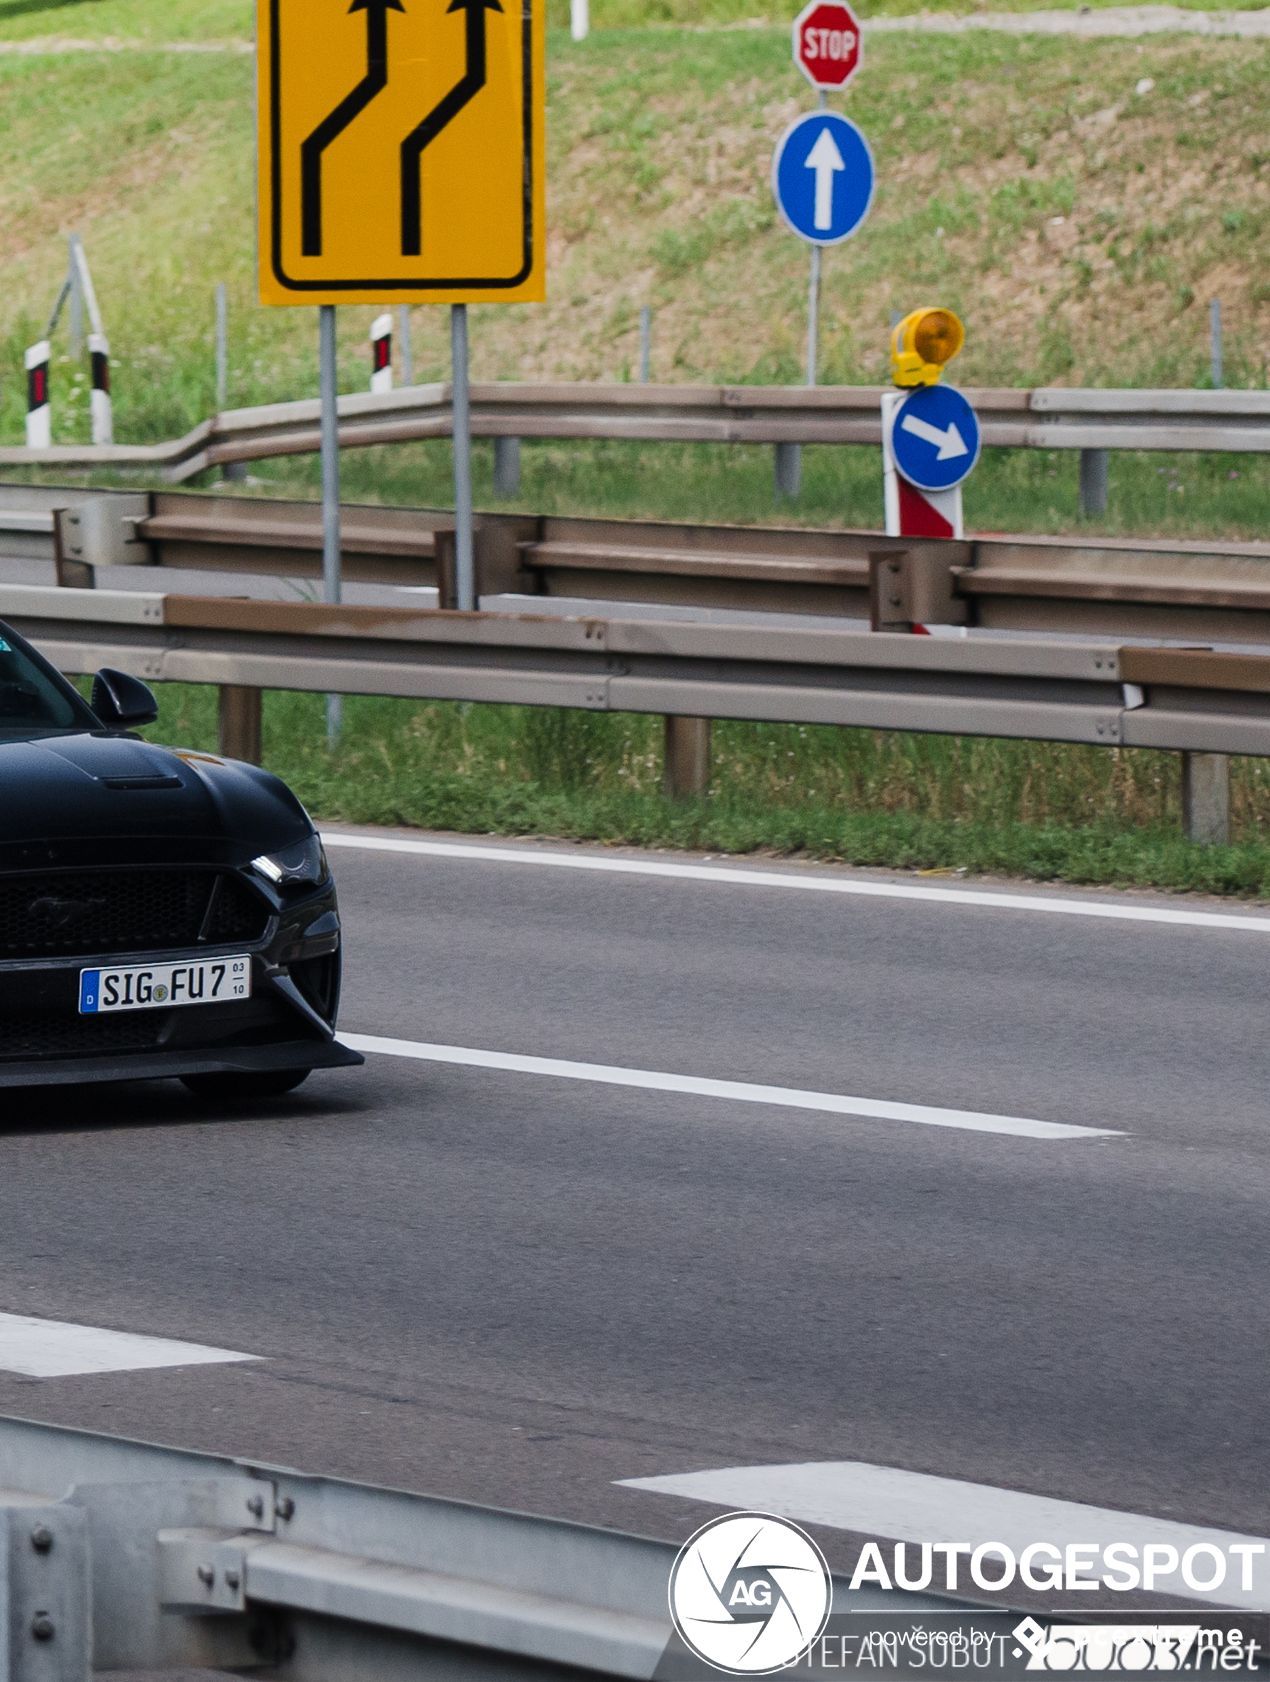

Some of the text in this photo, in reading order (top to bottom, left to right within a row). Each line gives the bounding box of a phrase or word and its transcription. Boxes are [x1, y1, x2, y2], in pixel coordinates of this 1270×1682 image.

[803, 26, 856, 62] STOP
[232, 962, 245, 972] 03
[102, 964, 226, 1006] SIG FU 7
[232, 984, 245, 994] 10
[86, 995, 94, 1005] D
